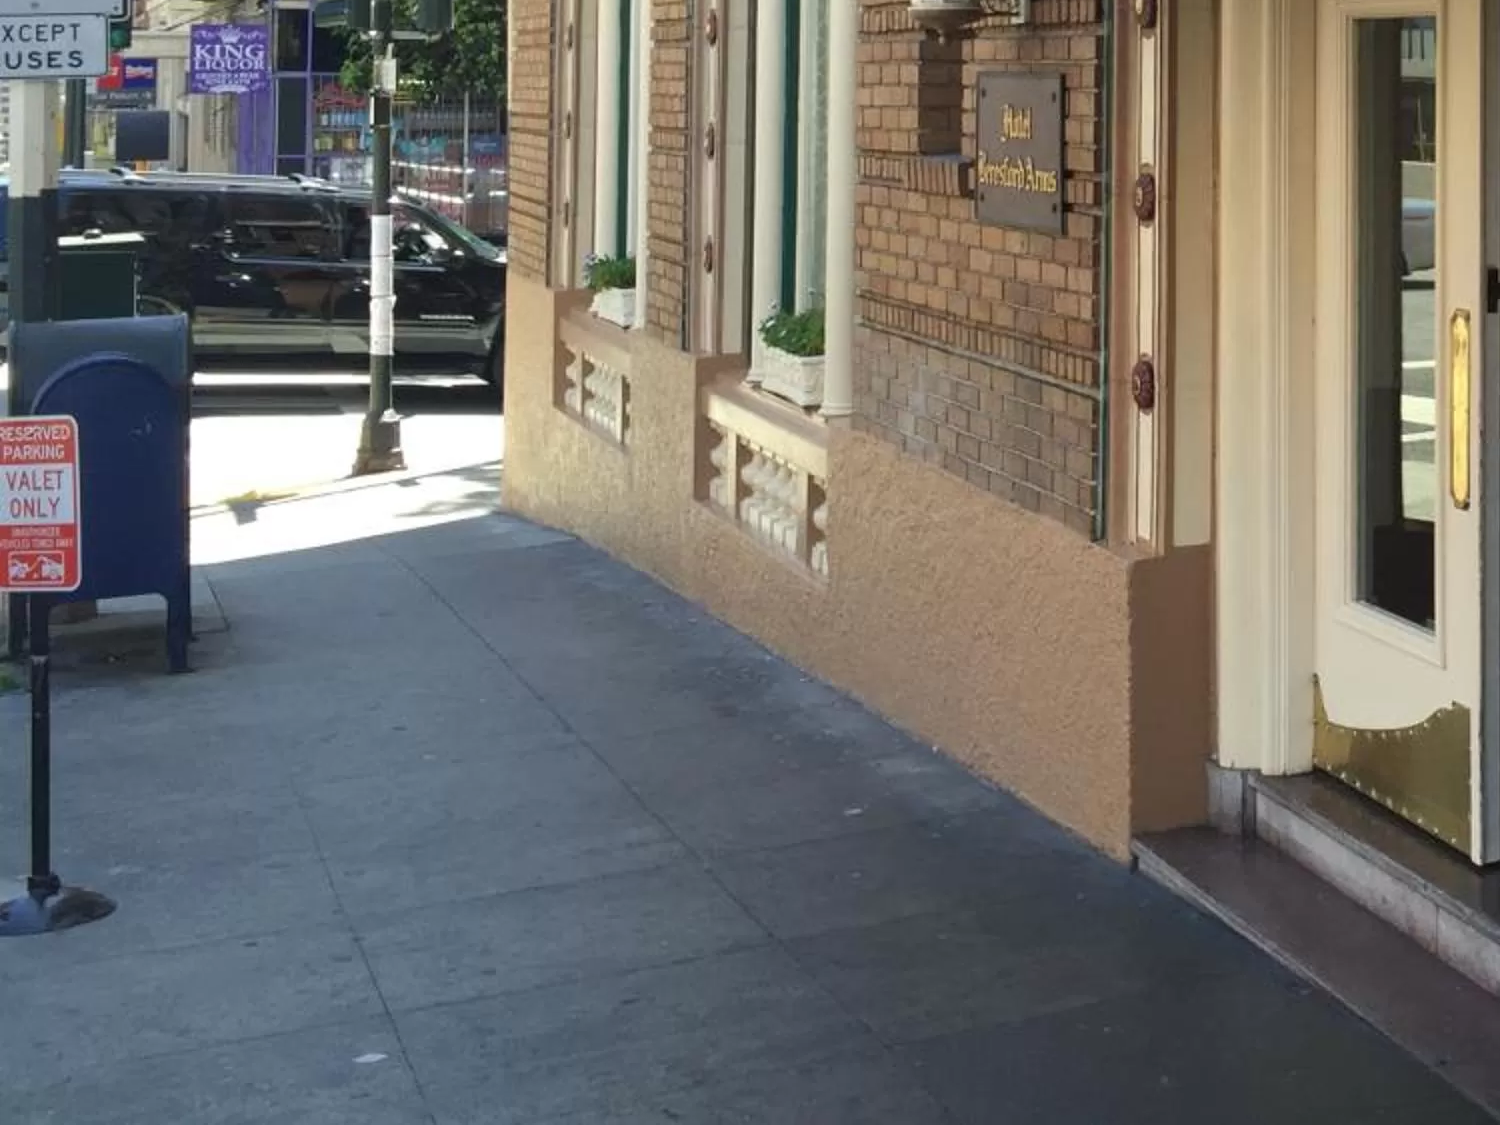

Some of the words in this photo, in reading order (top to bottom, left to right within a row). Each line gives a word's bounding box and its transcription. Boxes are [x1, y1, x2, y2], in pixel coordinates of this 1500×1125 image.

[194, 43, 266, 60] KING
[194, 58, 265, 72] LIQUOR
[0, 424, 71, 442] RESERVED
[3, 444, 65, 460] PARKING
[6, 469, 64, 492] VALET
[10, 496, 60, 520] ONLY
